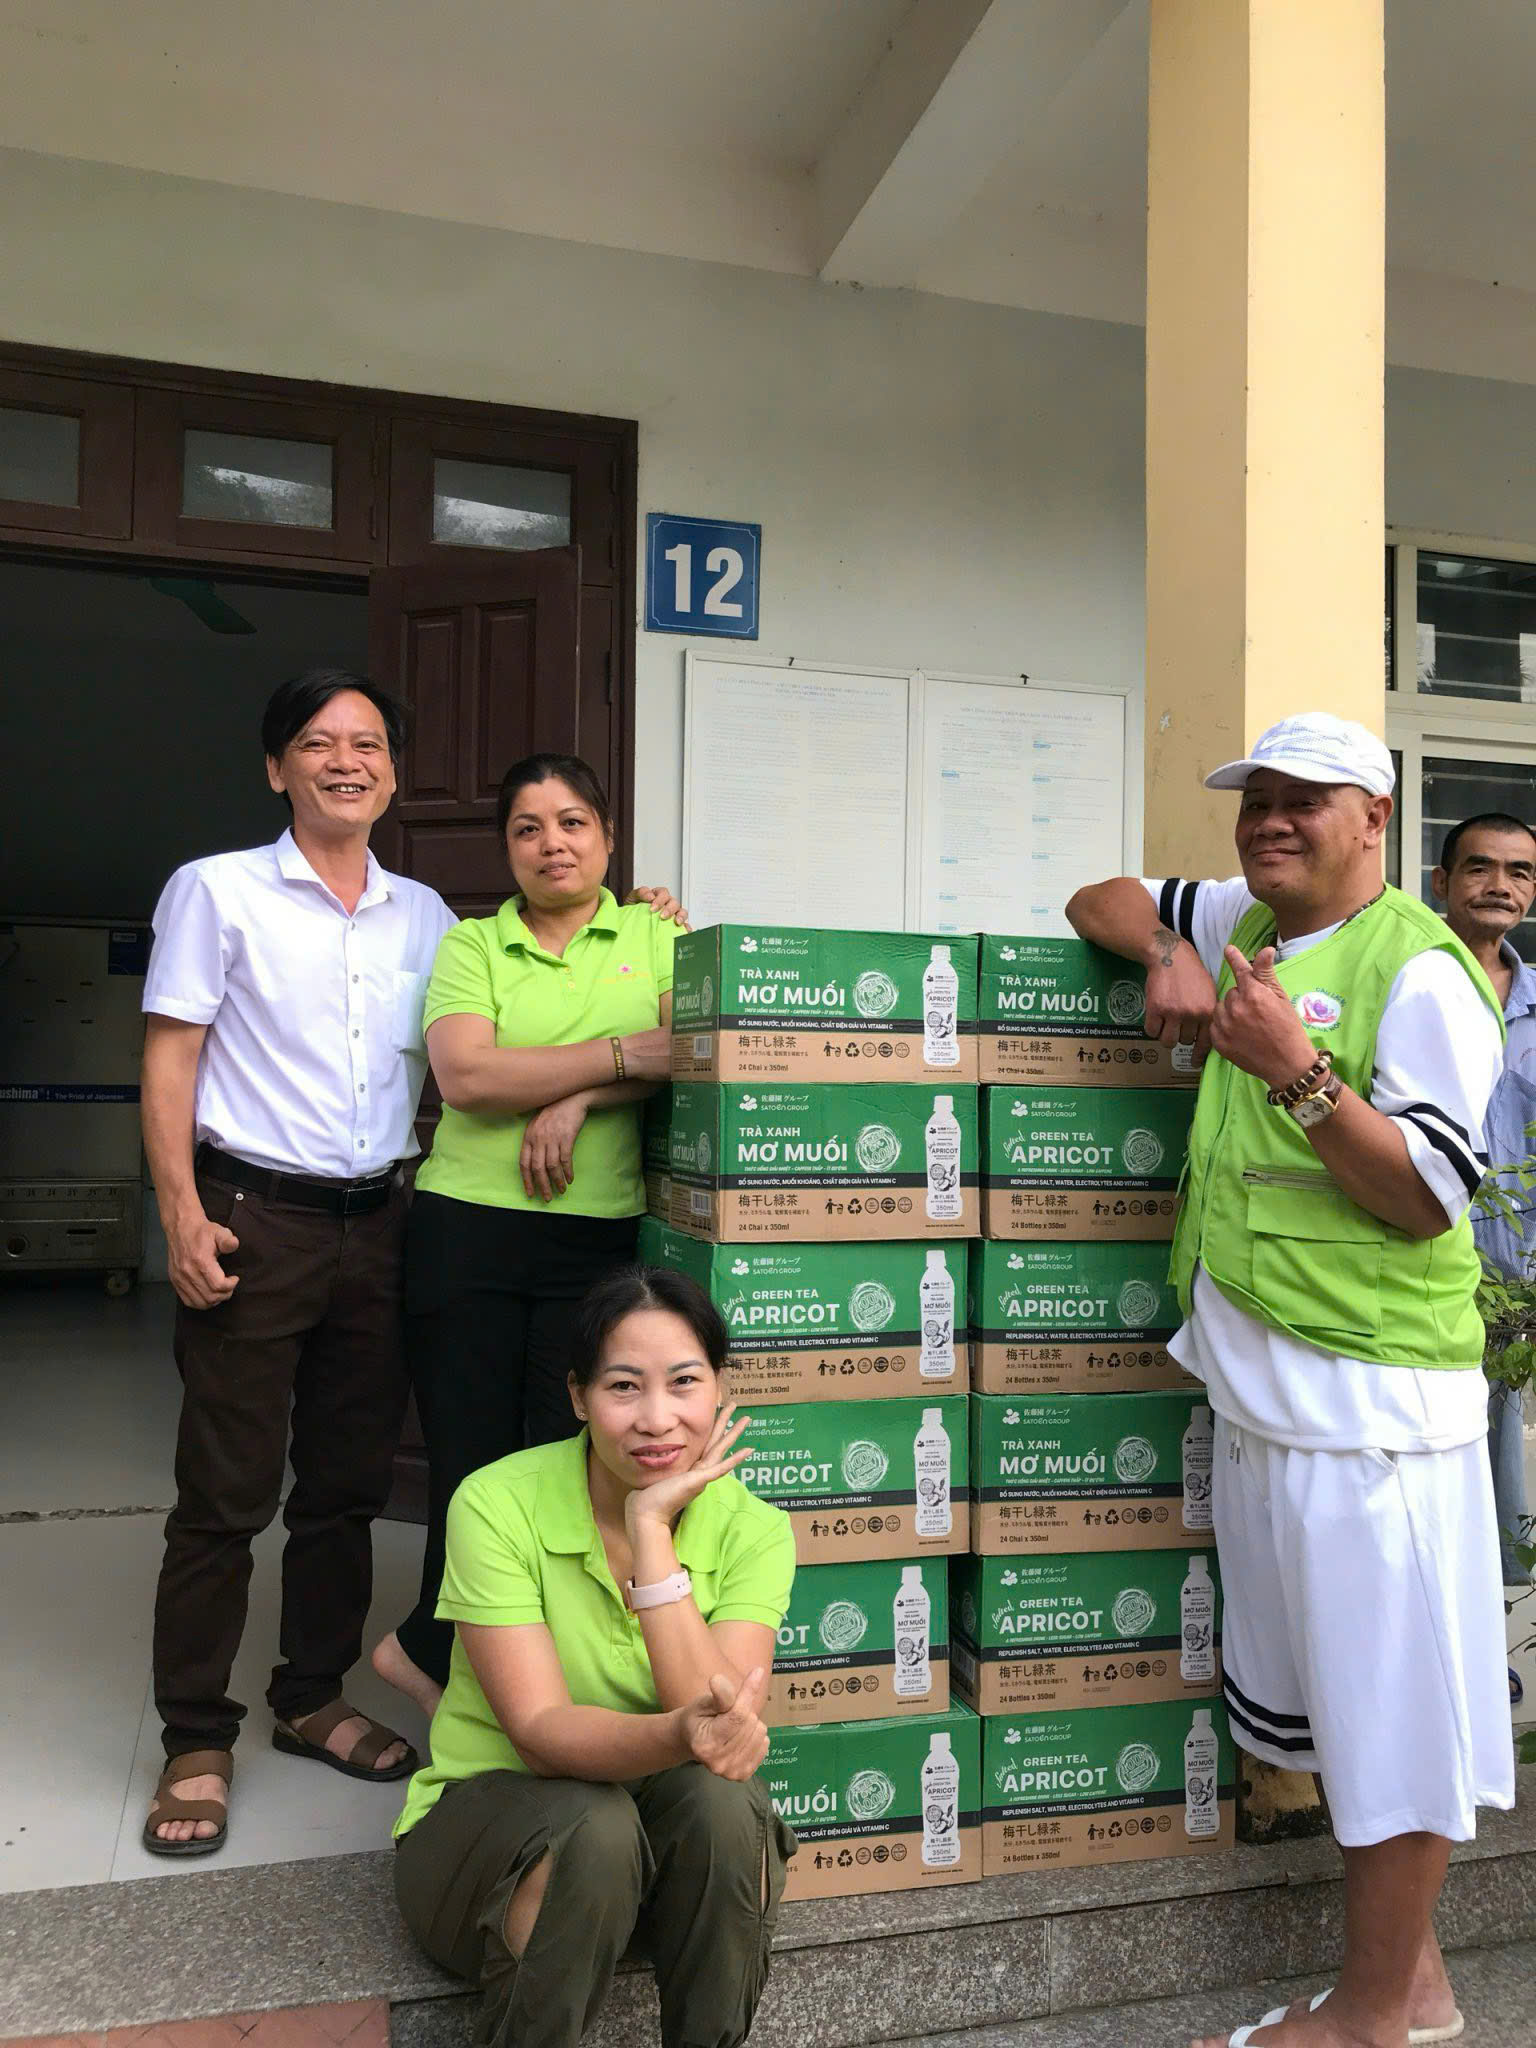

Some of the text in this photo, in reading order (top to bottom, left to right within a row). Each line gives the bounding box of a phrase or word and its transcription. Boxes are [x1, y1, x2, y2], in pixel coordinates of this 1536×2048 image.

[665, 544, 743, 618] 12
[740, 967, 799, 981] TRÀ XANH
[1000, 975, 1056, 987] TRÀ XANH
[738, 983, 777, 1004] MƠ
[784, 980, 845, 1006] MUỐI
[998, 988, 1098, 1013] MƠ MUỐI
[738, 1035, 797, 1048] 梅干し緑茶
[739, 1126, 800, 1137] TRÀ XANH
[1031, 1132, 1094, 1141] GREEN TEA
[738, 1135, 847, 1162] MƠ MUỐI
[1011, 1147, 1113, 1164] APRICOT
[739, 1178, 746, 1186] BỔ
[748, 1178, 762, 1186] SUNG
[871, 1177, 889, 1185] VITAMIN
[891, 1177, 896, 1185] C
[738, 1195, 798, 1207] 梅干し緑茶
[752, 1289, 819, 1299] GREEN TEA
[1027, 1285, 1089, 1294] GREEN TEA
[731, 1303, 840, 1326] APRICOT
[1006, 1300, 1108, 1317] APRICOT
[731, 1340, 760, 1348] REPLENISH
[762, 1340, 776, 1348] SALT,
[778, 1339, 798, 1348] WATER,
[799, 1338, 838, 1346] ELECTROLYTES
[731, 1357, 791, 1370] 梅干し緑茶
[740, 1387, 763, 1395] Bottles
[1002, 1438, 1060, 1450] TRÀ XANH
[788, 1450, 811, 1460] TEA
[1000, 1448, 1105, 1474] MƠ MUỐI
[740, 1463, 832, 1486] PRICOT
[791, 1497, 831, 1507] ELECTROLYTES
[844, 1496, 866, 1504] VITAMIN
[1000, 1506, 1057, 1518] 梅干し緑茶
[1020, 1597, 1083, 1609] GREEN TEA
[999, 1610, 1103, 1634] APRICOT
[822, 1657, 844, 1666] VITAMIN
[1009, 1693, 1030, 1702] Bottles
[1037, 1692, 1056, 1701] 350ml
[1023, 1754, 1088, 1767] GREEN TEA
[1003, 1767, 1107, 1792] APRICOT
[770, 1781, 788, 1791] NH
[772, 1784, 837, 1816] MUỐI
[1003, 1806, 1031, 1816] REPLENISH
[1032, 1805, 1046, 1814] SALT,
[1047, 1804, 1067, 1813] WATER,
[1068, 1801, 1107, 1811] ELECTROLYTES
[1107, 1800, 1118, 1808] AND
[853, 1825, 861, 1834] VÀ
[862, 1825, 884, 1833] VITAMIN
[1003, 1822, 1060, 1837] 梅干し緑茶
[1012, 1853, 1033, 1862] Bottles
[1041, 1851, 1060, 1860] 350ml
